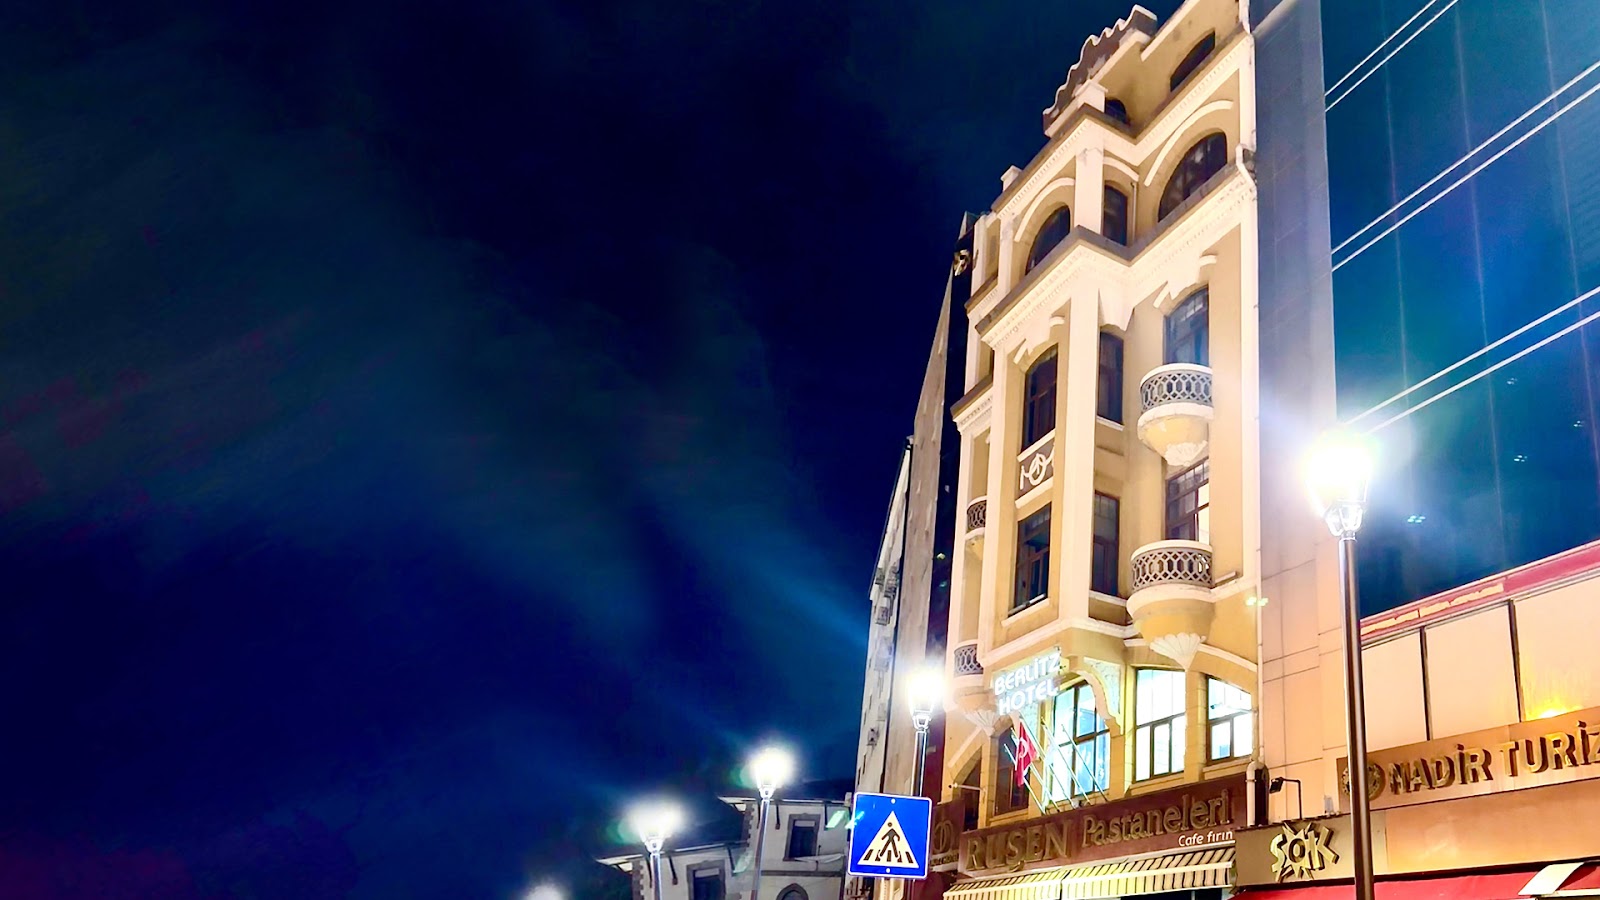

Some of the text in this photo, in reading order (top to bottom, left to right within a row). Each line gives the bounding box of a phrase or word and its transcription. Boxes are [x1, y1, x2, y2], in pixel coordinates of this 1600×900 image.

[999, 678, 1059, 715] HOTEL
[1389, 744, 1492, 795] NADİR
[966, 819, 1072, 872] RUŞEN
[1081, 789, 1231, 848] Pastaneleri
[1178, 833, 1204, 847] Cafe
